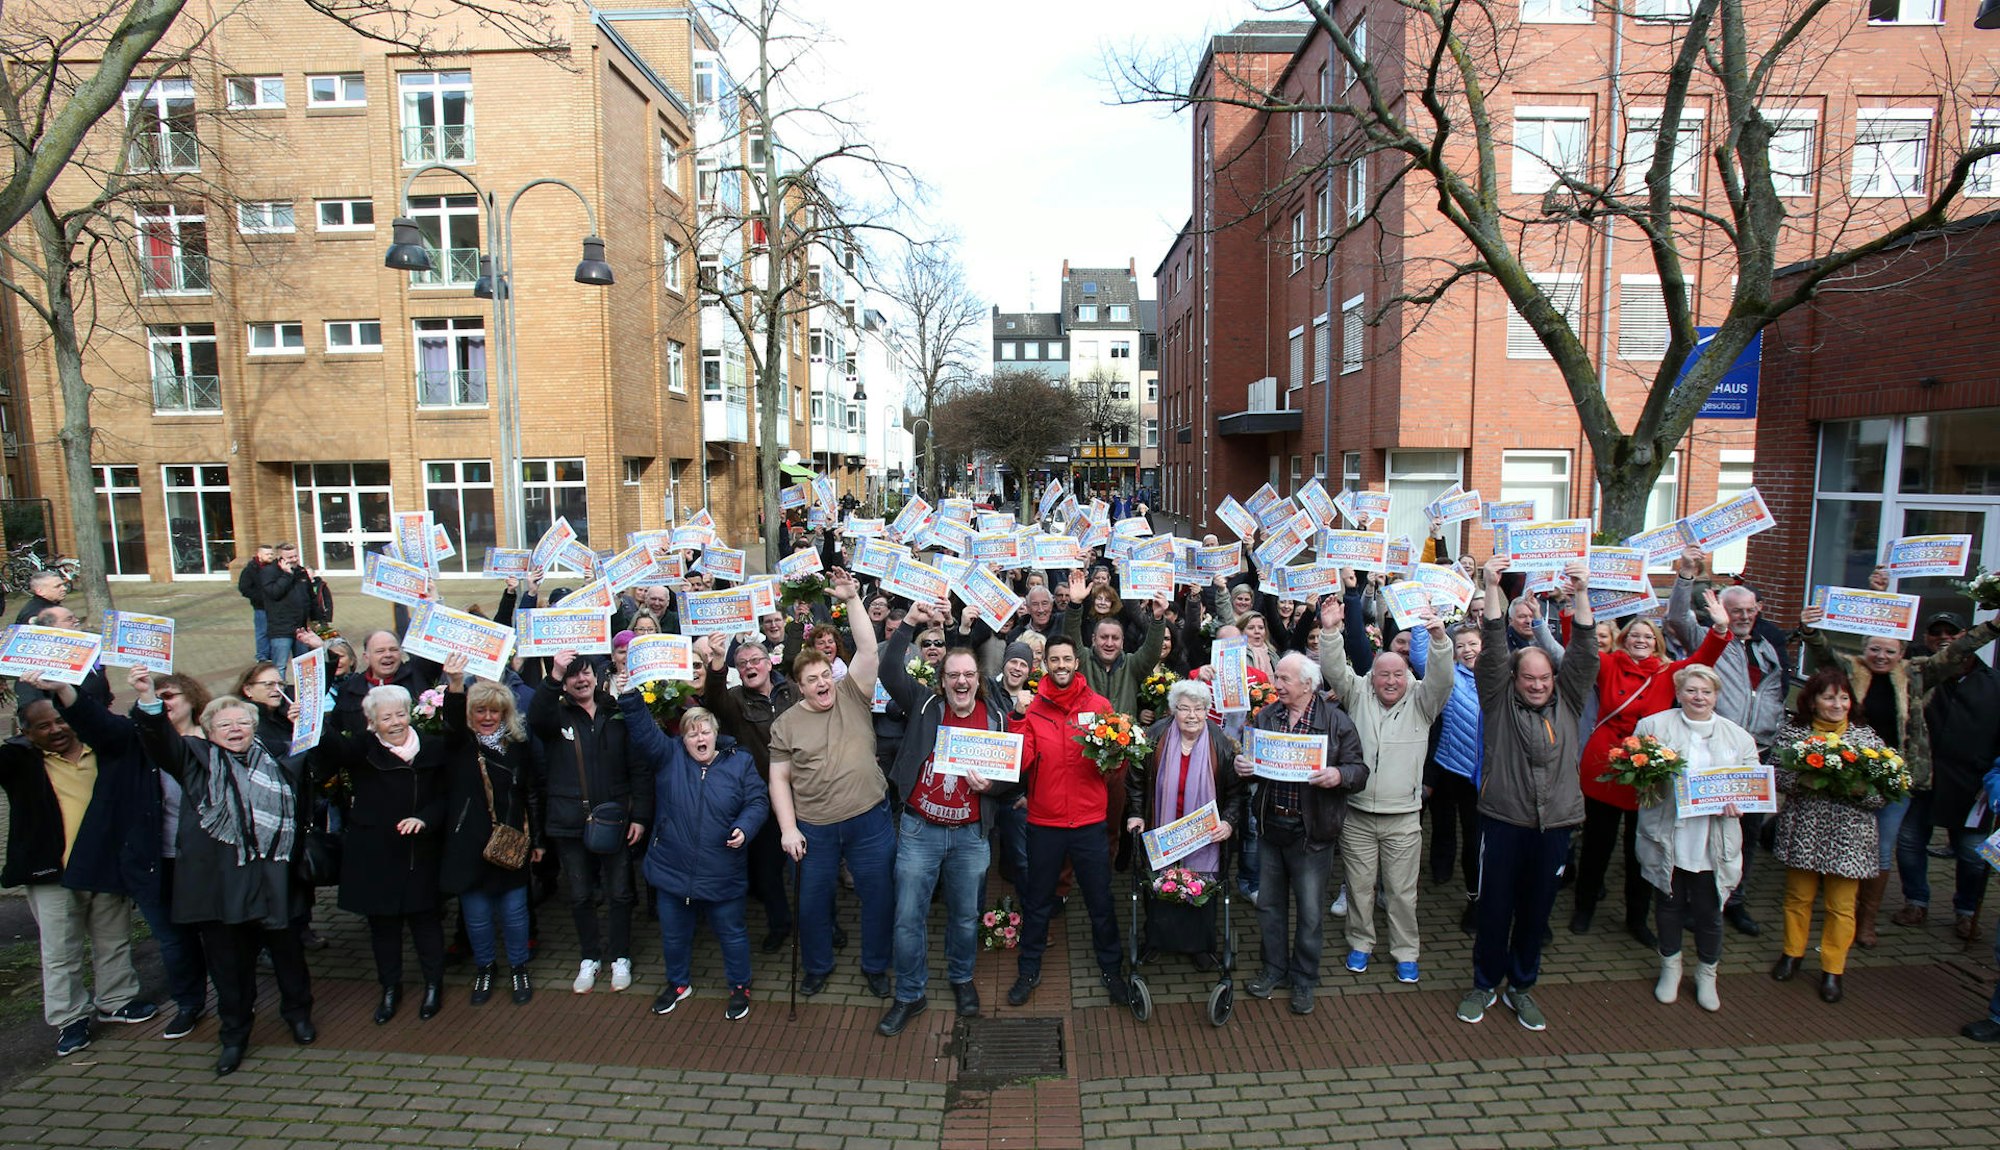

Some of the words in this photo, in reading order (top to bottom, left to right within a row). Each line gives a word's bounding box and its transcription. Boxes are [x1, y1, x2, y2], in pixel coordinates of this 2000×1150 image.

[1712, 383, 1748, 393] HAUS
[1831, 594, 1868, 602] POSTCODE
[1869, 598, 1909, 606] LOTTERIE
[121, 621, 151, 630] POSTCODE
[697, 615, 744, 624] MONATSGEWINN
[1834, 614, 1898, 627] MONATSGEWINN
[433, 613, 468, 628] POSTCODE
[468, 623, 504, 639] LOTTERIE
[18, 632, 54, 642] POSTCODE
[56, 638, 94, 648] LOTTERIE
[432, 636, 490, 659] MONATSGEWINN
[9, 655, 72, 669] MONATSGEWINN
[952, 734, 984, 743] POSTCODE
[984, 738, 1015, 747] LOTTERIE
[1257, 737, 1287, 745] POSTCODE
[1288, 740, 1319, 748] LOTTERIE
[955, 757, 1007, 768] MONATSGEWINN
[1261, 760, 1312, 771] MONATSGEWINN
[1700, 795, 1759, 804] MONATSGEWINN
[936, 806, 965, 818] DIABLO
